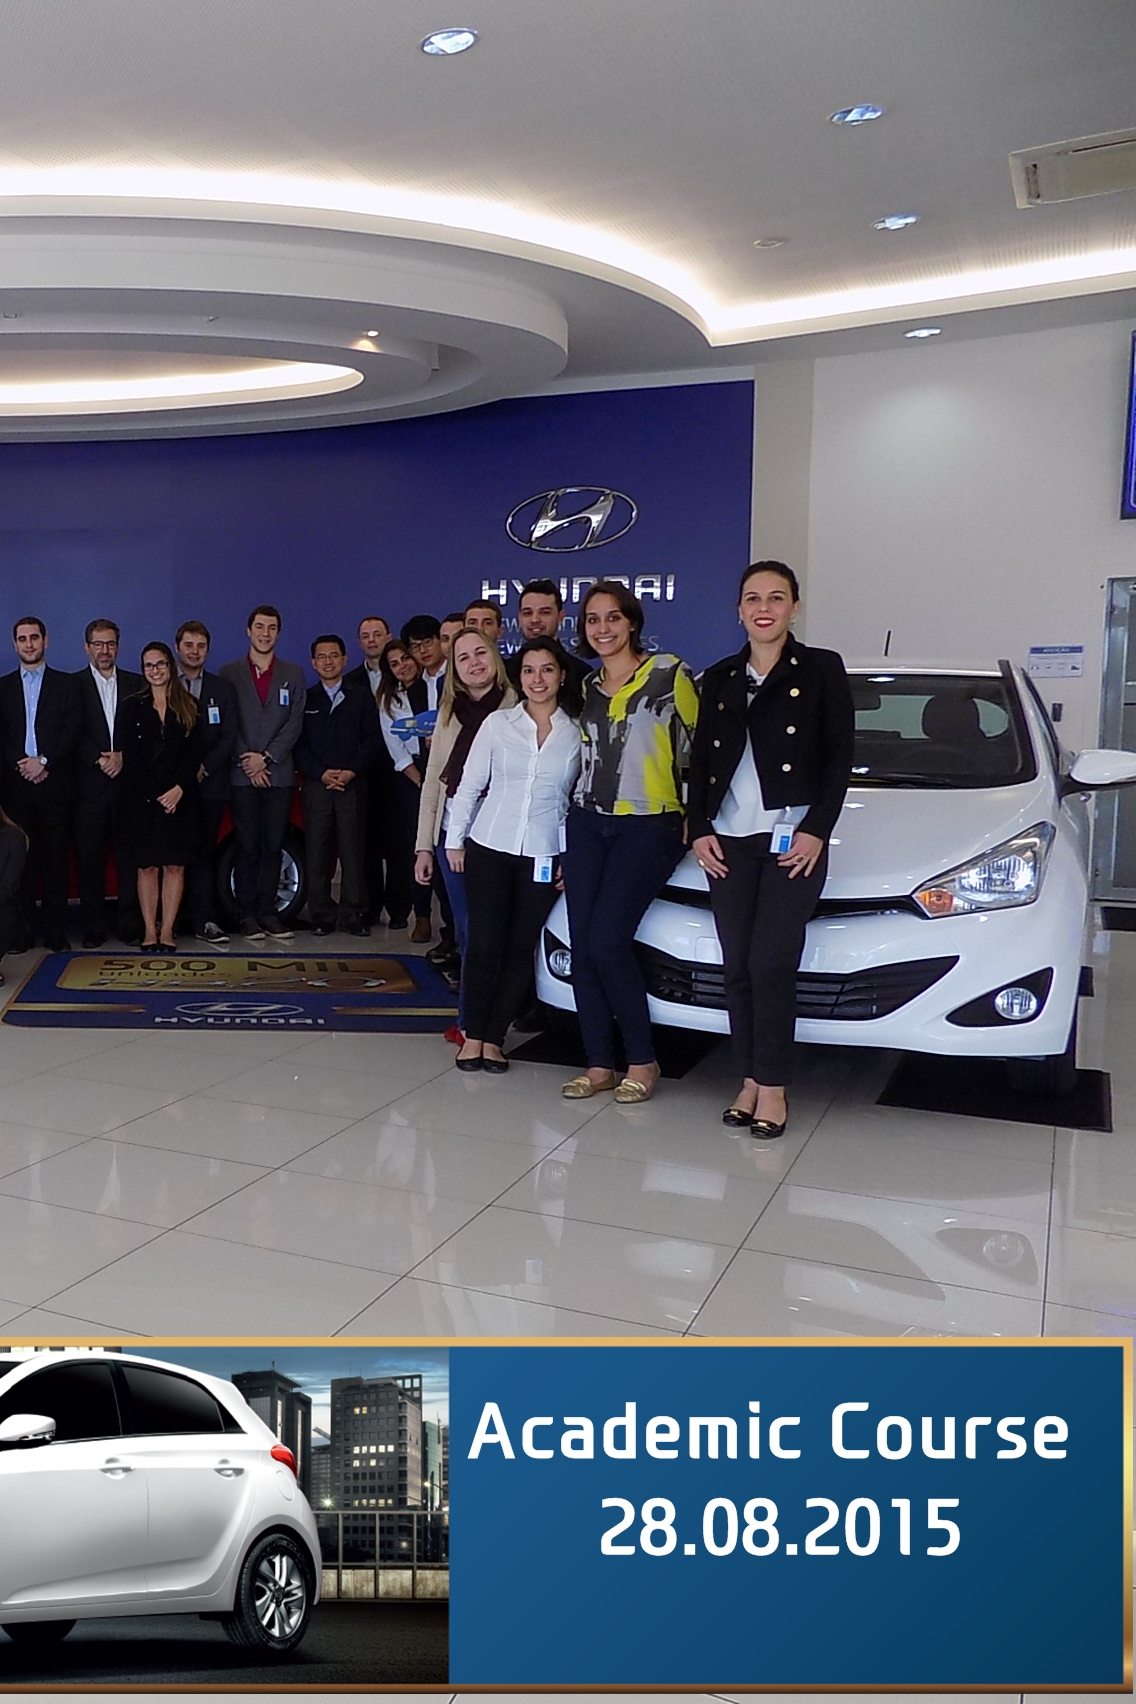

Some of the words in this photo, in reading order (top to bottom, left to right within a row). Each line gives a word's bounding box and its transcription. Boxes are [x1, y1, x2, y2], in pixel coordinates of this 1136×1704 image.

[100, 959, 216, 971] 500
[247, 961, 376, 972] MIL
[154, 1016, 325, 1025] HYUNDAI
